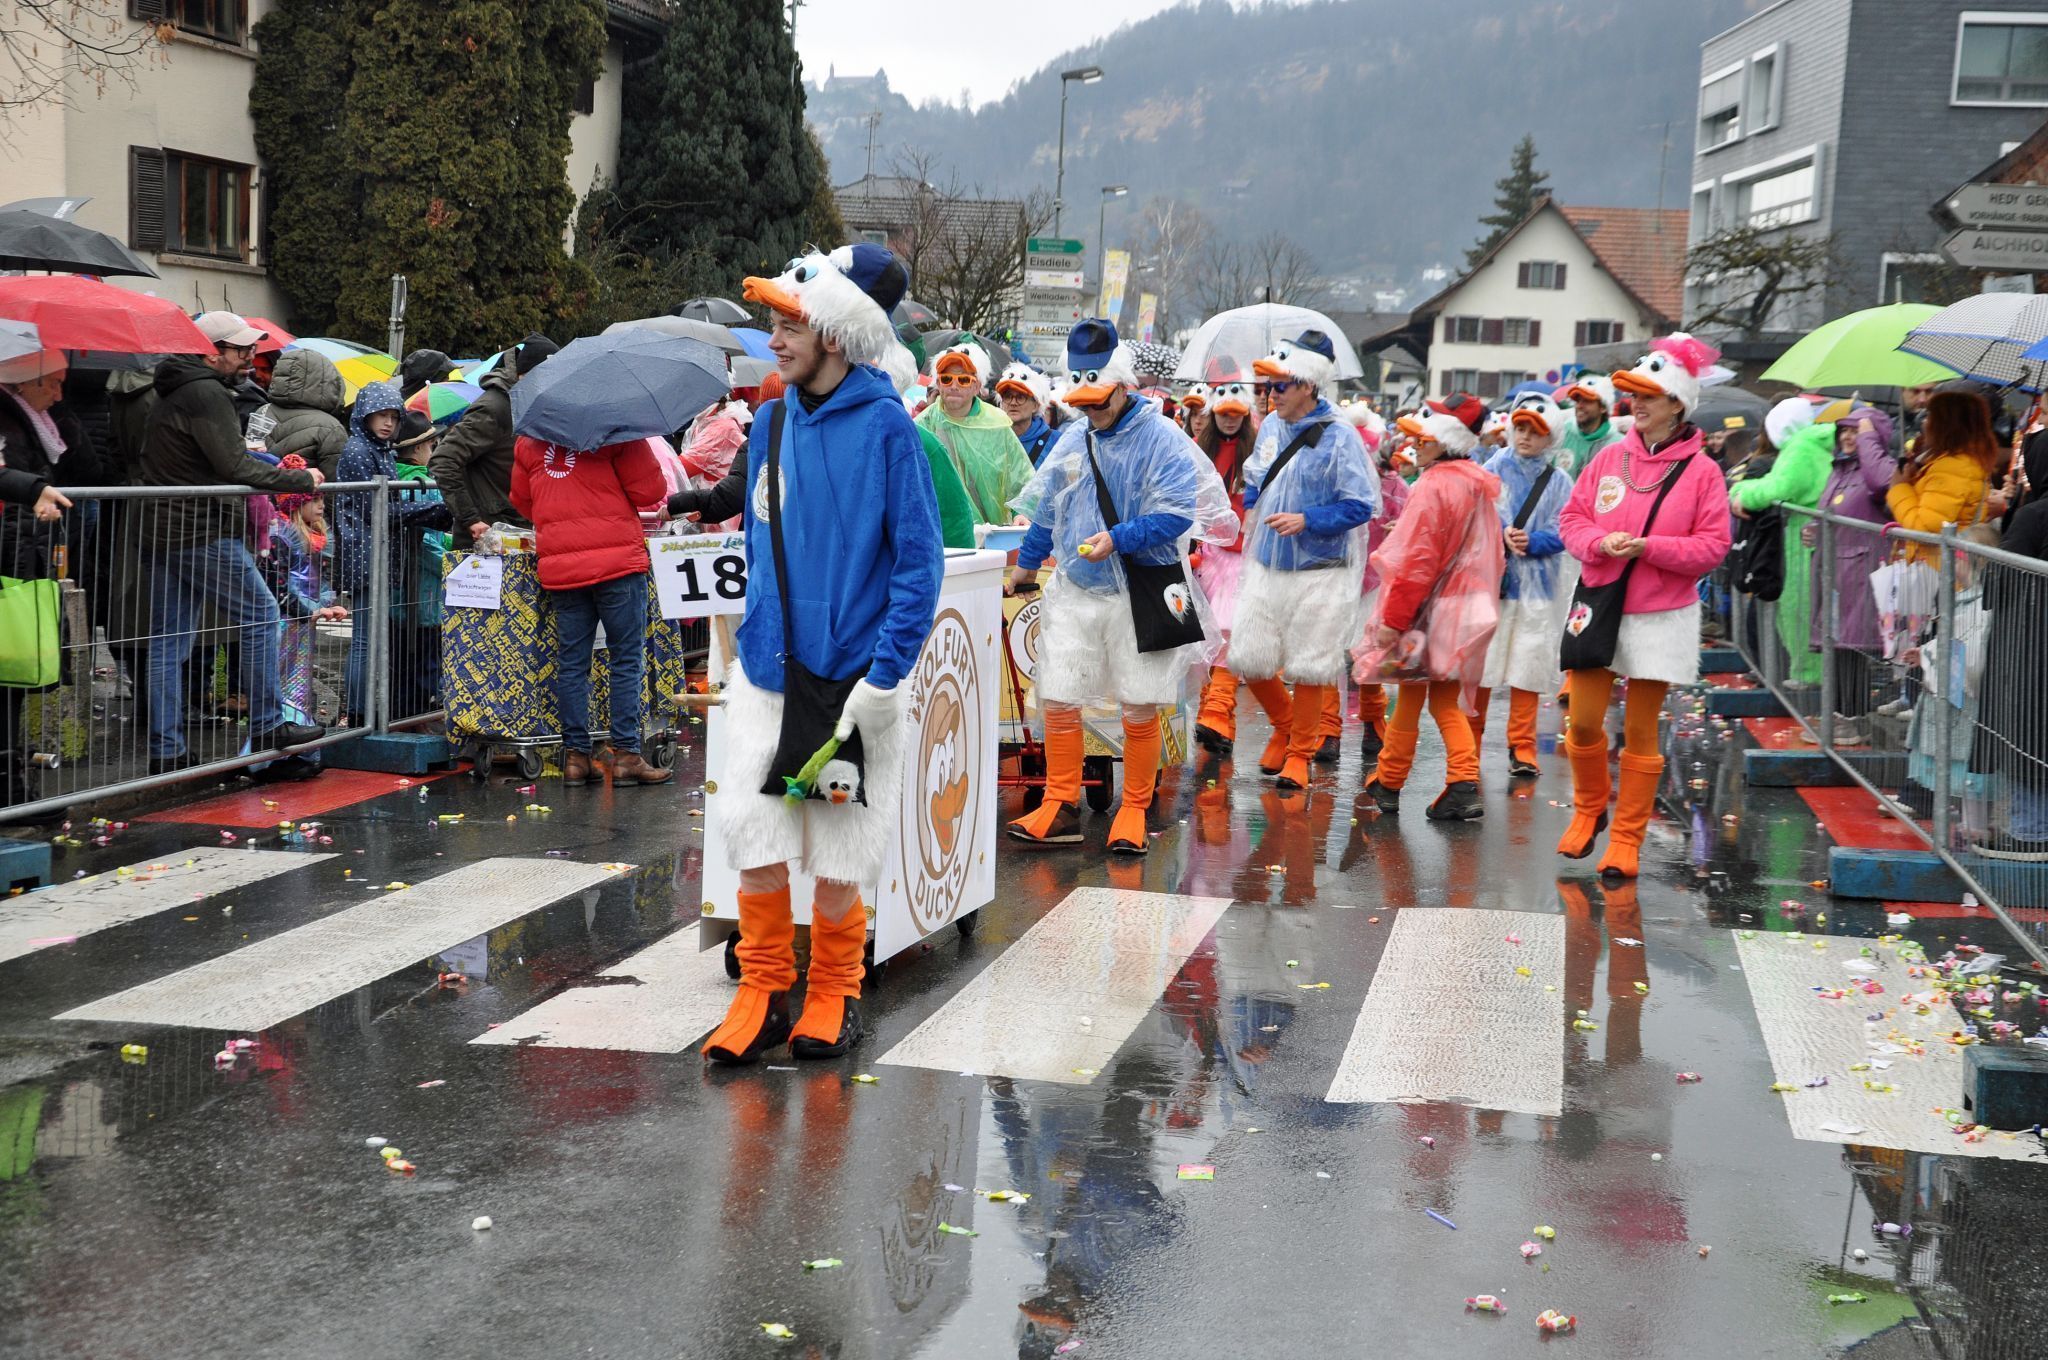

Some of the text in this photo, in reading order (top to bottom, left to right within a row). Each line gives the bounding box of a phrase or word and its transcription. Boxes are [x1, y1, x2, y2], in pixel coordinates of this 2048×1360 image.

[1030, 256, 1071, 268] Eisdiele
[676, 555, 748, 602] 18
[907, 628, 974, 724] WOLFURT
[915, 853, 961, 920] DUCKS
